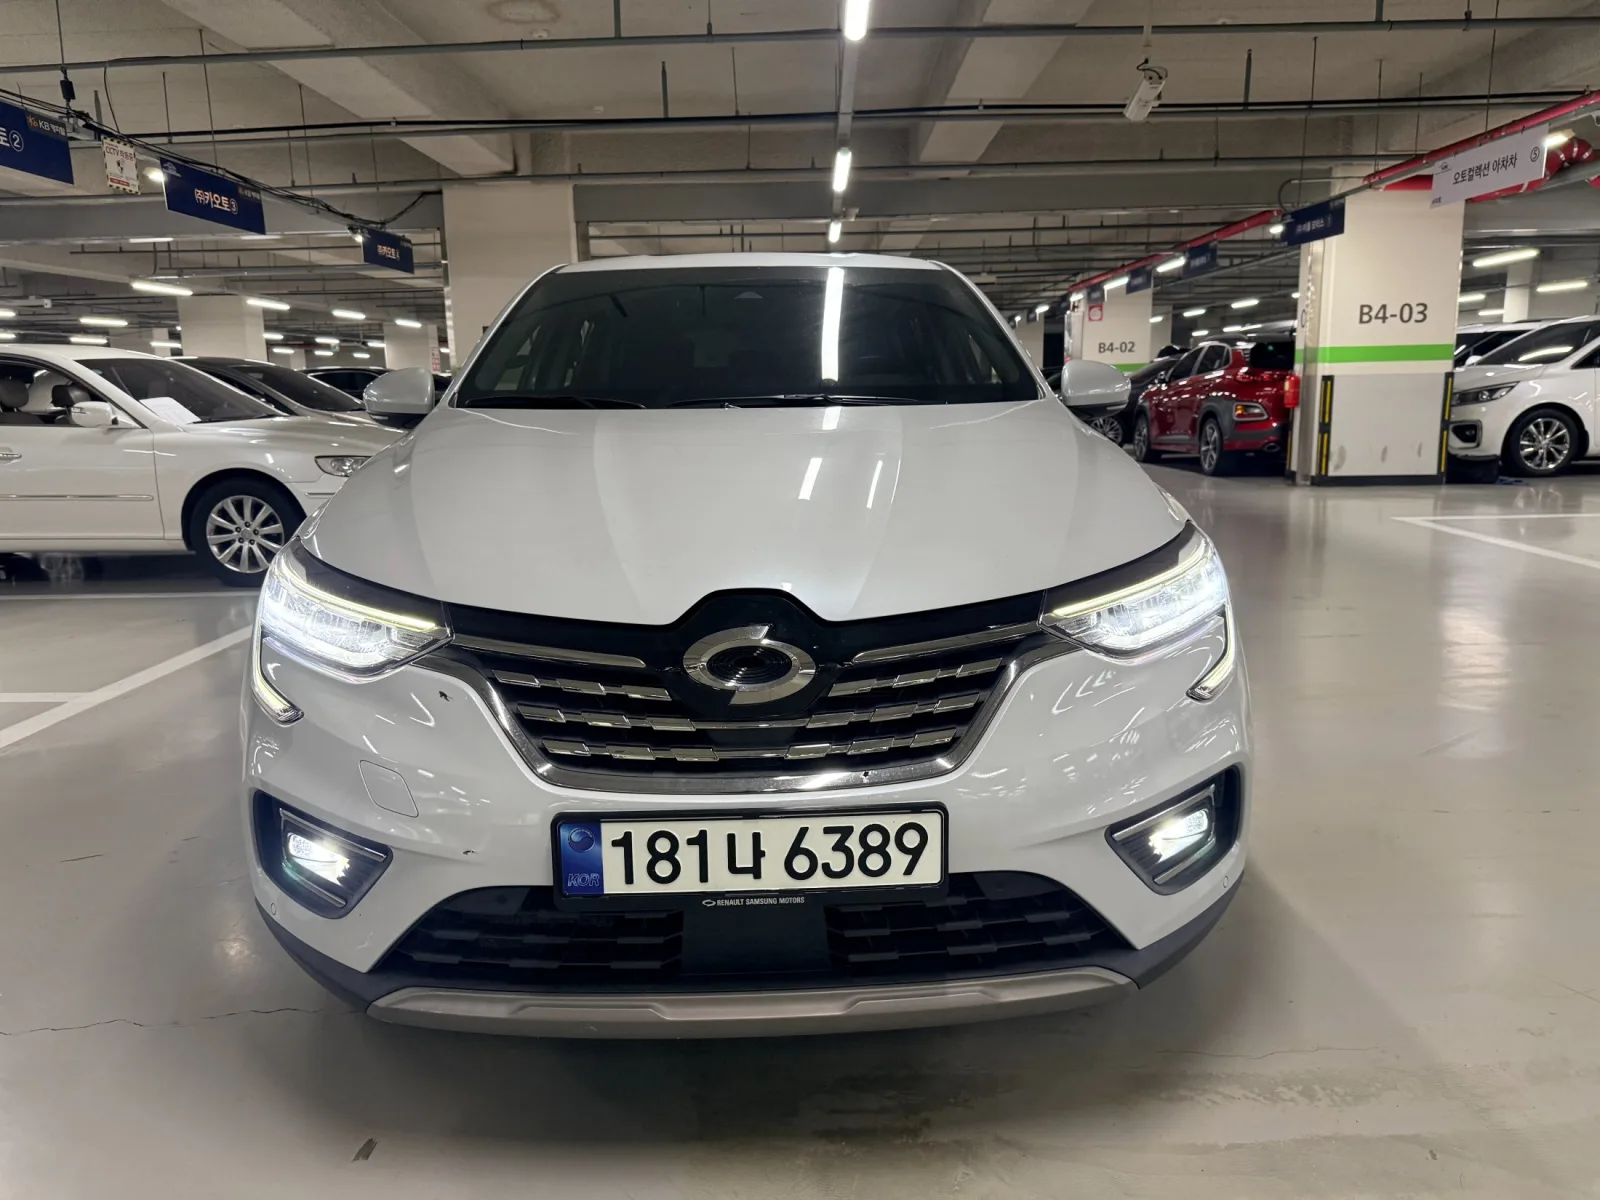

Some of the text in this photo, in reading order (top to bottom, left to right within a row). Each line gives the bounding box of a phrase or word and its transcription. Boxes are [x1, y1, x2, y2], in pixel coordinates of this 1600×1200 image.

[1492, 152, 1517, 174] 아차차
[1358, 302, 1428, 325] B4-03
[1098, 341, 1136, 354] B4-02
[611, 821, 929, 885] 181나 6389
[567, 872, 601, 887] KOR
[716, 896, 805, 906] RENAULT SAMSUNG MOTORS
